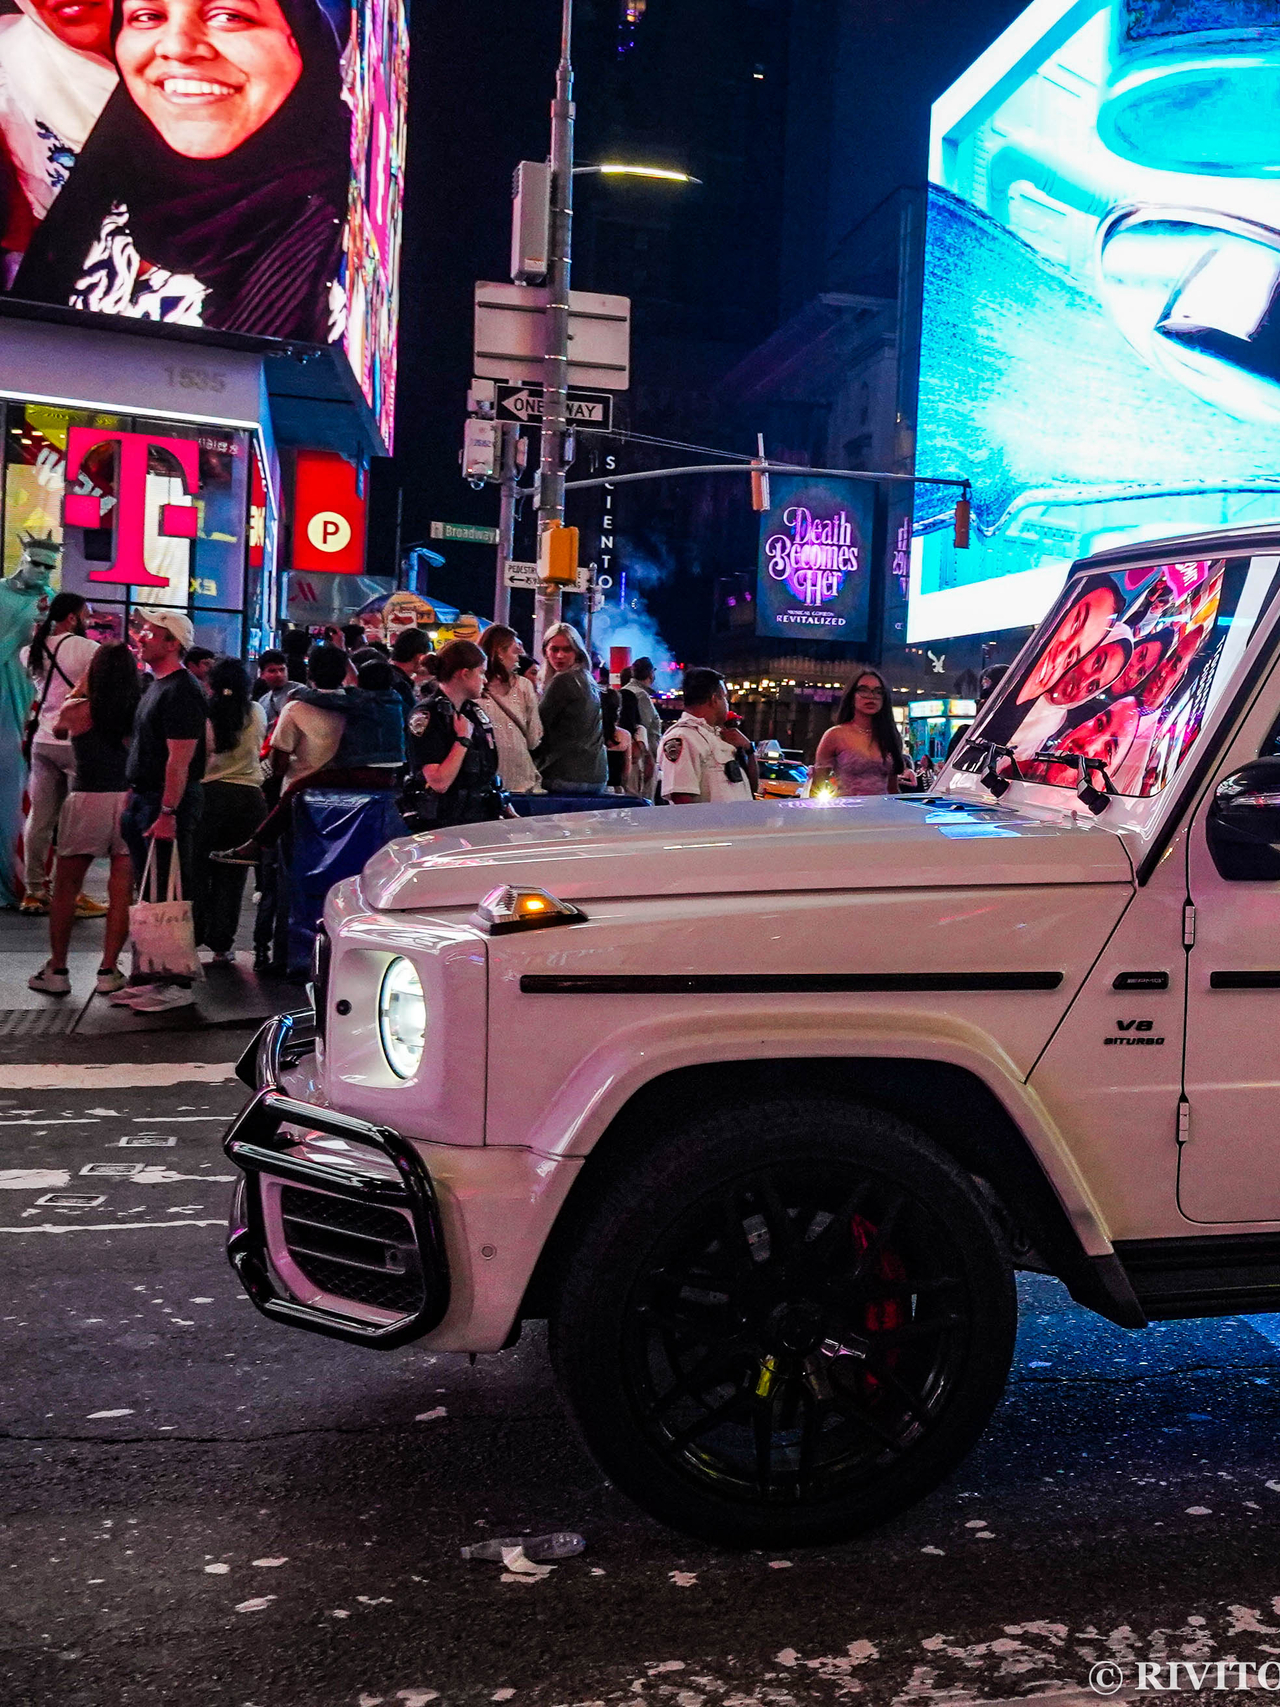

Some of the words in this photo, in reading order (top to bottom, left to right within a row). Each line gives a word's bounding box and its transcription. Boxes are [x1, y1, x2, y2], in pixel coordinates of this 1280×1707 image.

[514, 399, 544, 414] ONE
[566, 403, 597, 418] WAY
[322, 520, 340, 545] P
[446, 524, 496, 544] Broadway
[783, 506, 852, 546] Death
[765, 534, 859, 580] Becomes
[793, 569, 843, 607] Her
[776, 614, 847, 626] REVITALIZED
[1116, 1020, 1154, 1032] V8
[1103, 1037, 1165, 1046] BITURBO
